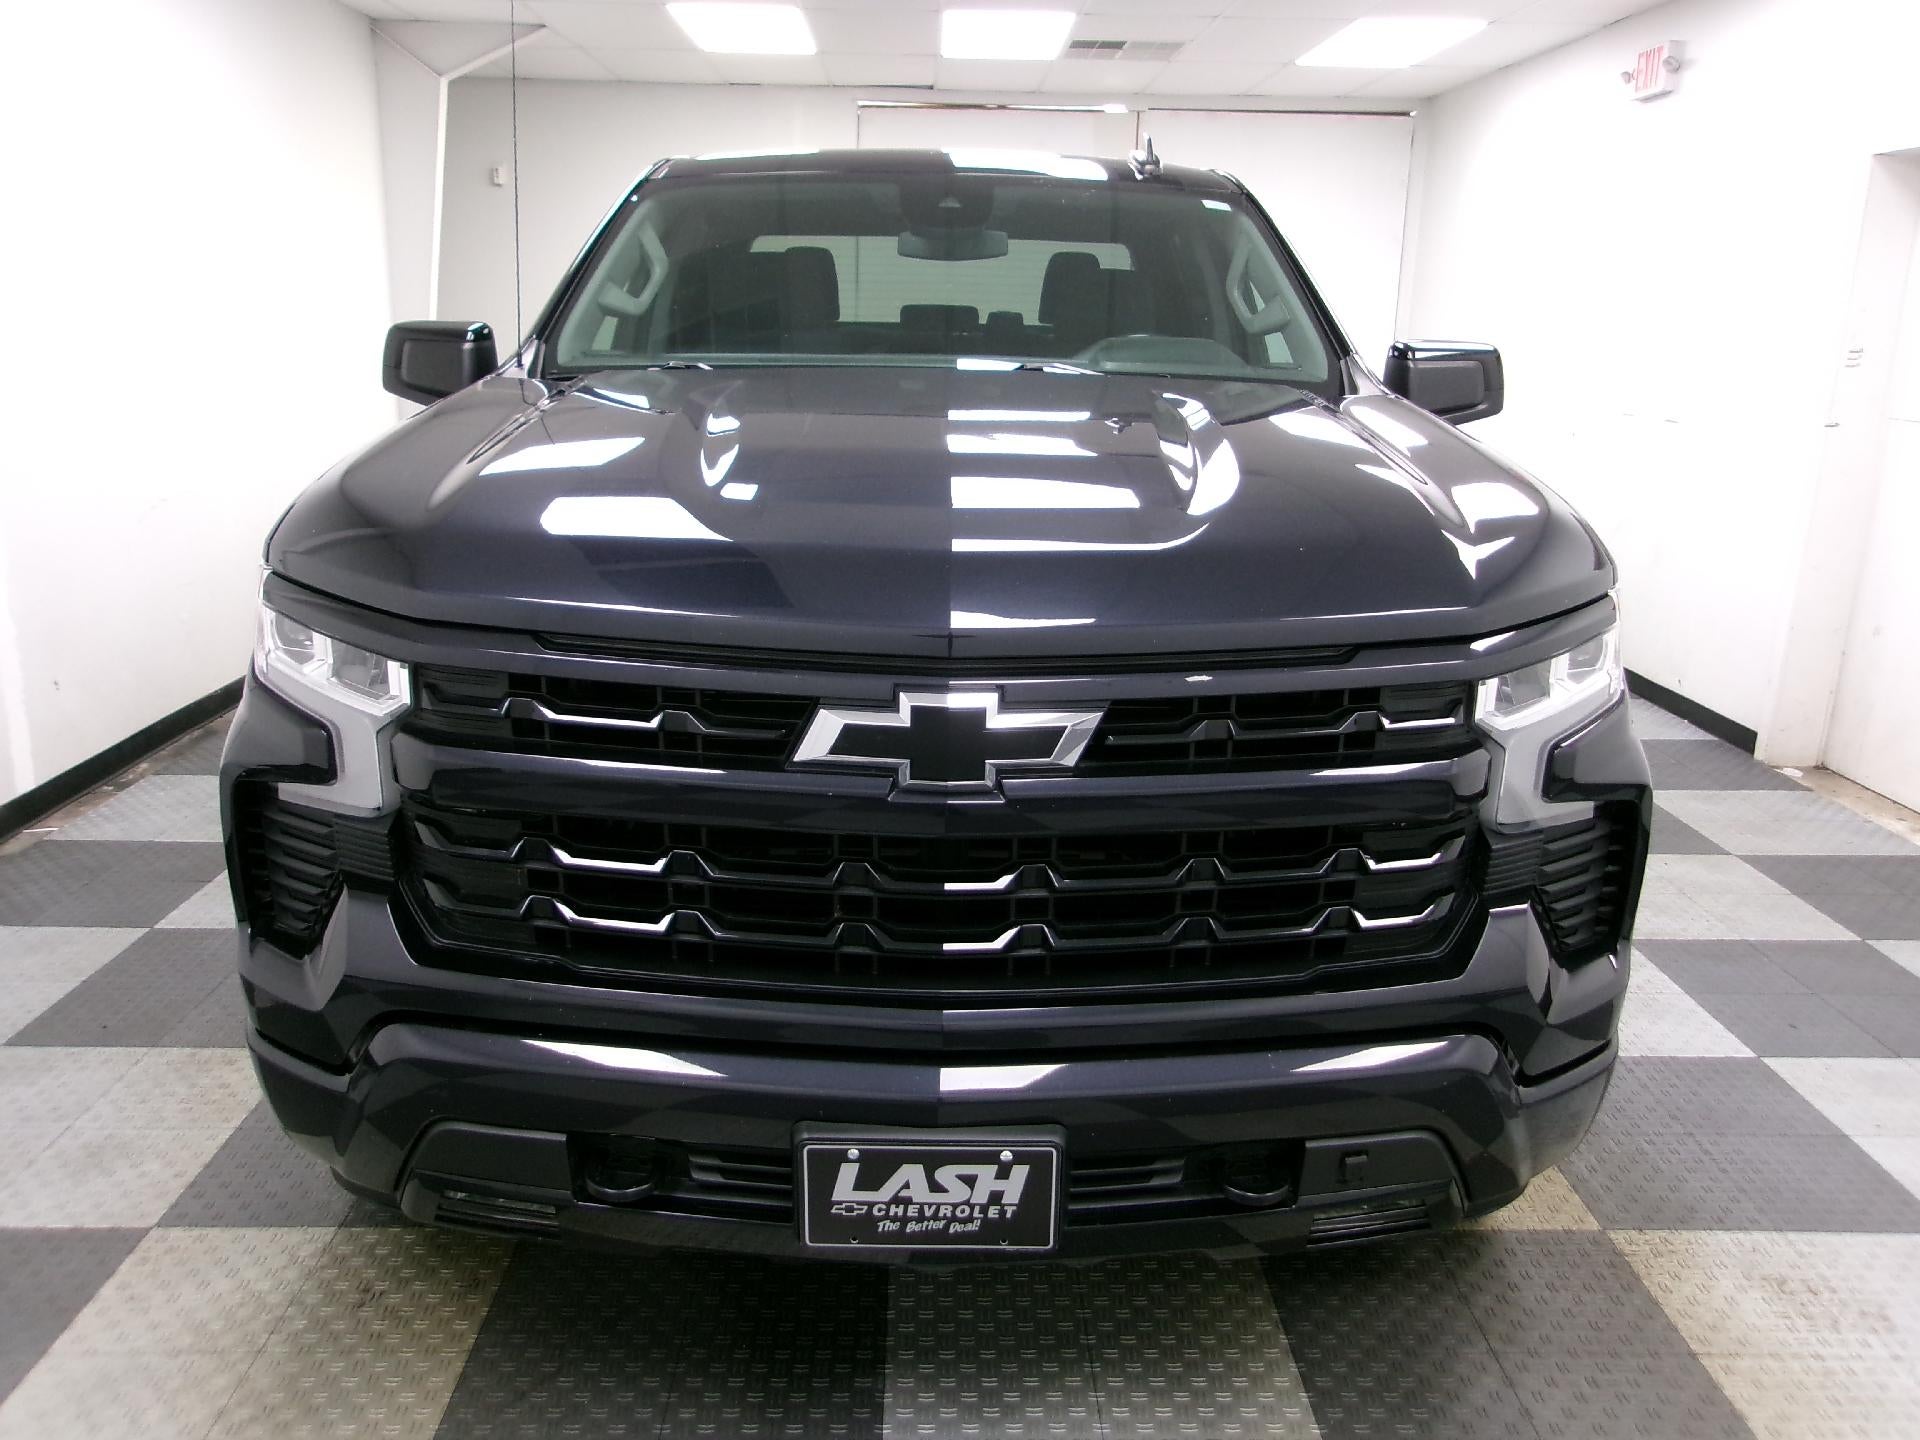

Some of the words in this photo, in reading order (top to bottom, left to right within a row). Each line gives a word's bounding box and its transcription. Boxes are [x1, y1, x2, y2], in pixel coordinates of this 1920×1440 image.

[1635, 45, 1664, 92] EXIT
[831, 1162, 1030, 1205] LASH
[872, 1203, 1017, 1218] CHEVROLET
[877, 1220, 900, 1232] The
[906, 1219, 947, 1233] Better
[949, 1219, 980, 1233] Deal!
